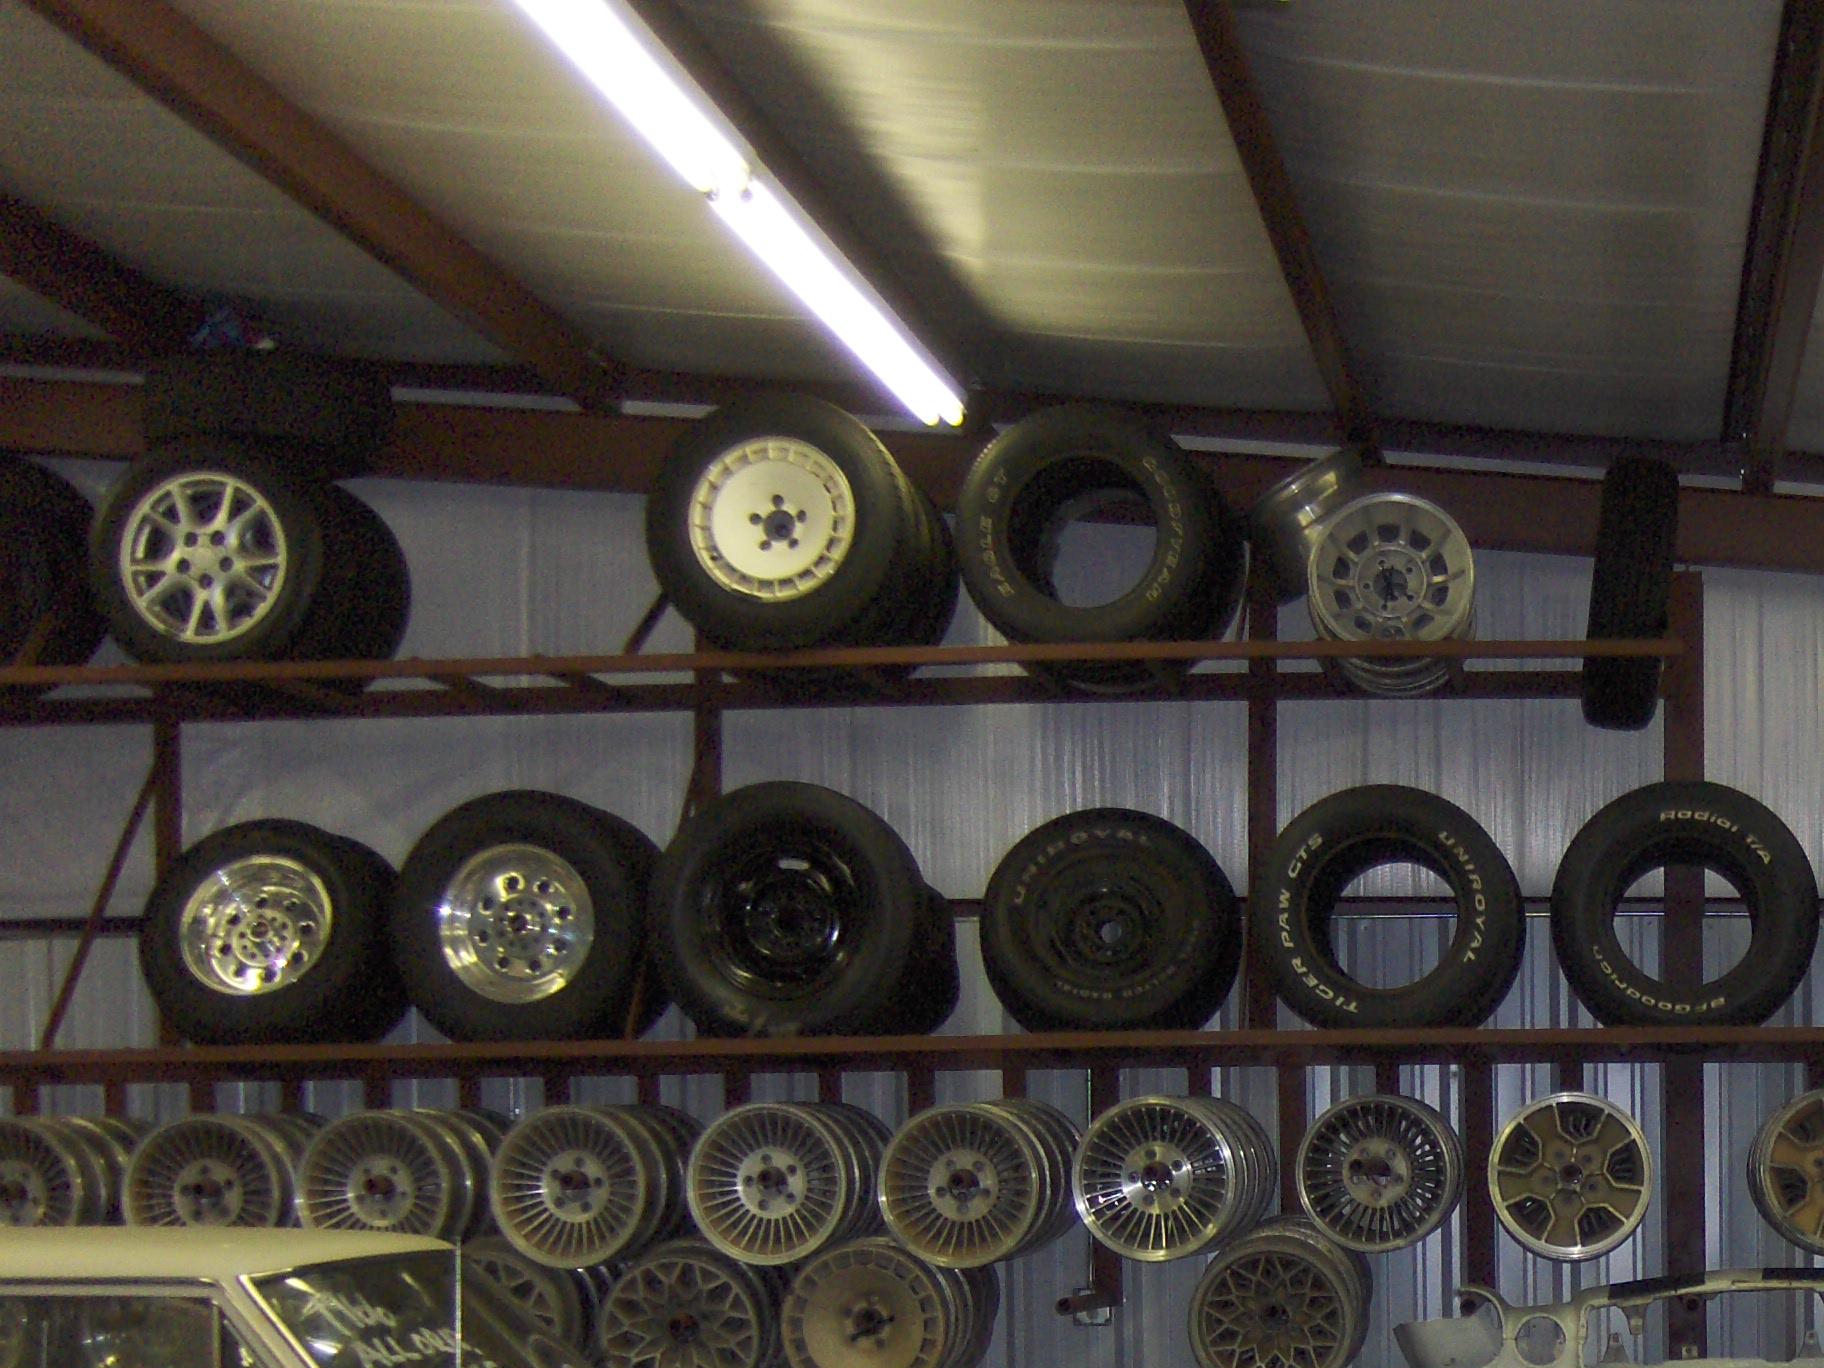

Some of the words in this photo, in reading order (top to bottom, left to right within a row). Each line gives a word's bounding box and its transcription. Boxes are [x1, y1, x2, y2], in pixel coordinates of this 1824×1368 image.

[1142, 455, 1184, 602] GOODYEAR
[1659, 809, 1740, 833] Radial
[1744, 833, 1773, 865] T/A
[1278, 888, 1295, 948] PAW
[1437, 830, 1488, 963] UNIROYAL
